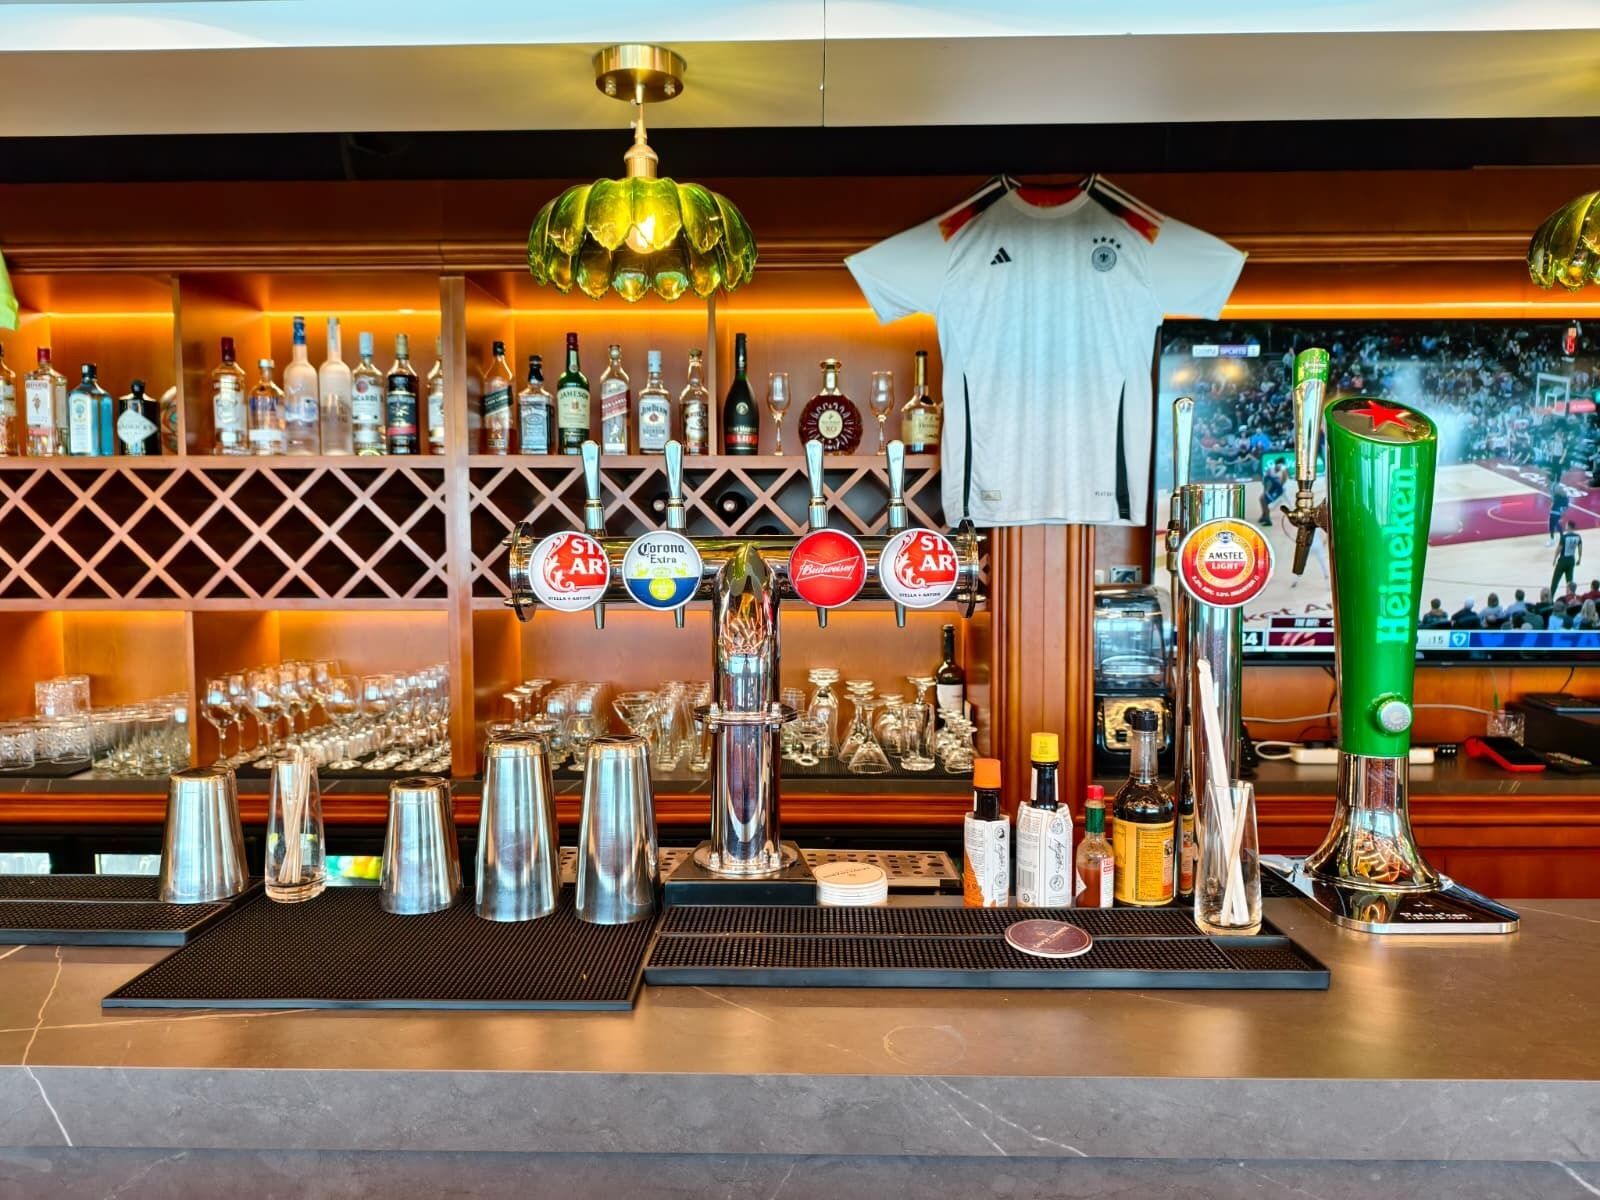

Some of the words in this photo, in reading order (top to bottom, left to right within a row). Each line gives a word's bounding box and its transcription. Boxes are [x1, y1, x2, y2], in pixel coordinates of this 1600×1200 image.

[559, 390, 589, 400] JAMESON
[640, 406, 651, 416] JIM
[652, 403, 668, 415] BEAM
[571, 538, 602, 554] ST
[637, 542, 686, 557] Corona
[920, 535, 952, 551] ST
[650, 554, 677, 564] Extra
[919, 554, 957, 572] AR
[1208, 551, 1244, 560] AMSTEL
[1376, 468, 1417, 644] Heineken
[569, 557, 608, 576] AR
[801, 562, 855, 577] Budweiser
[1211, 562, 1239, 570] LIGHT
